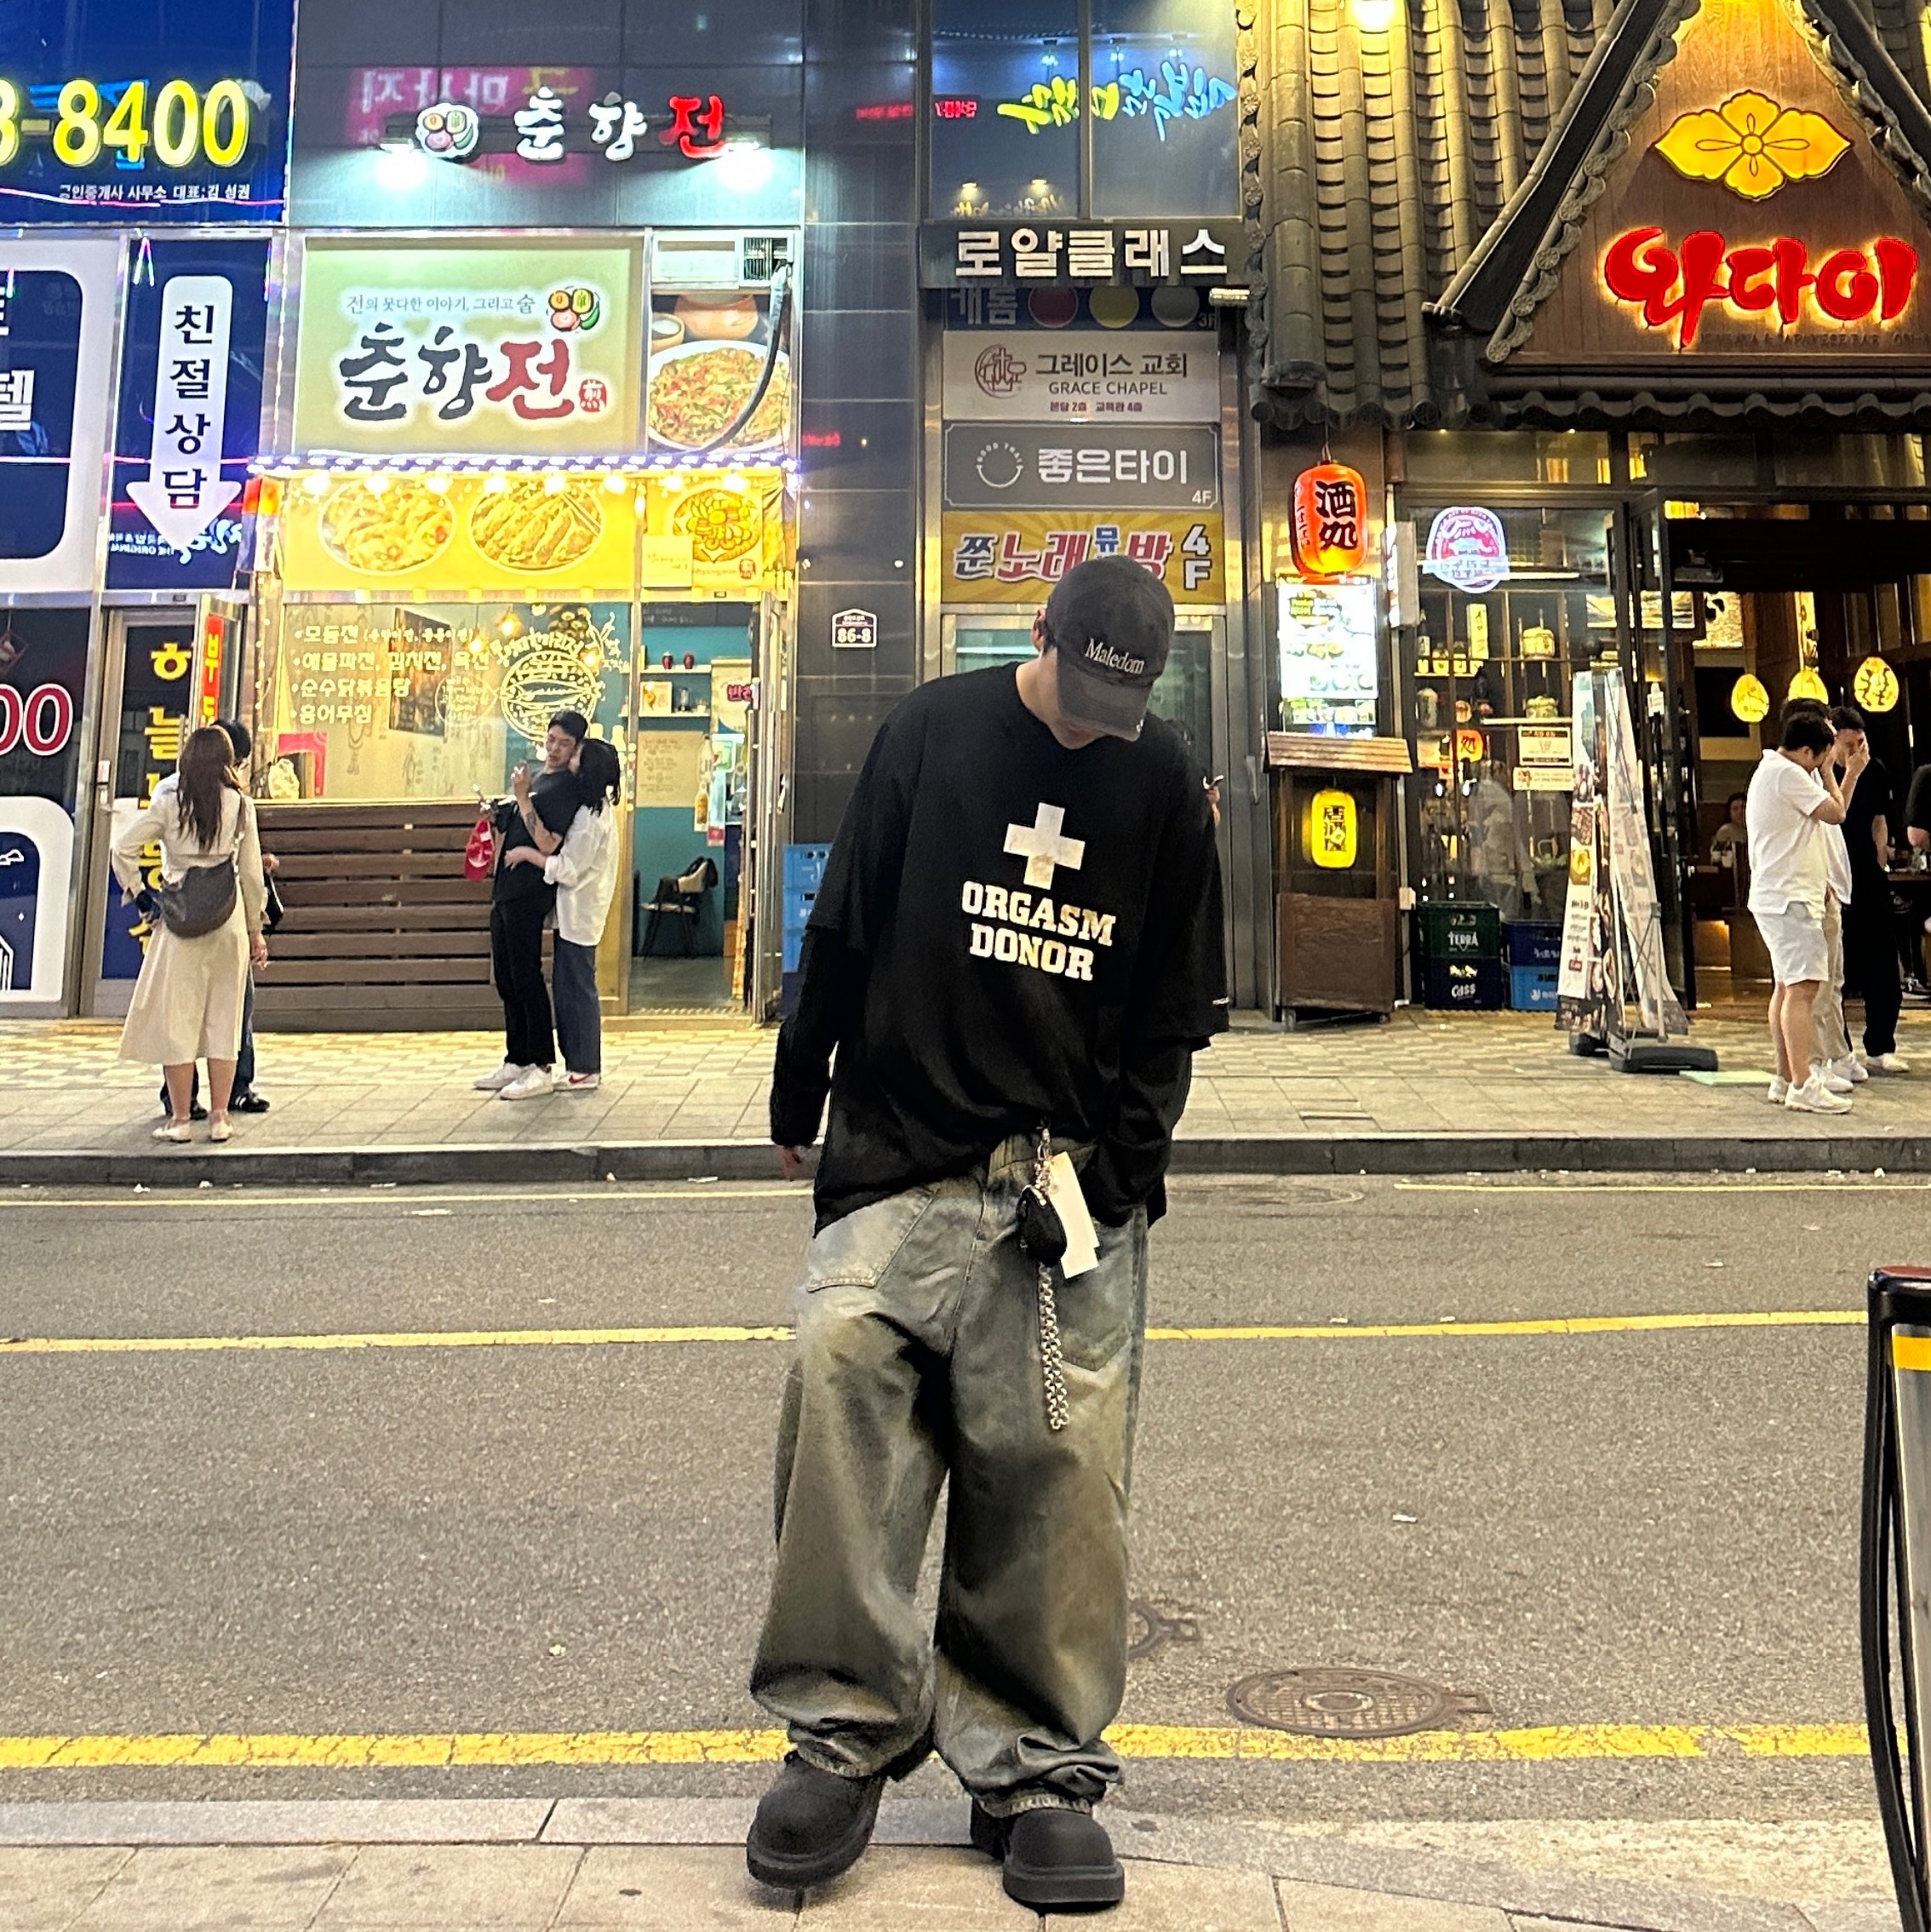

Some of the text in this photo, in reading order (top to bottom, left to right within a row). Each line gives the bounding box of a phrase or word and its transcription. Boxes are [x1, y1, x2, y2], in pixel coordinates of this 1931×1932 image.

[513, 86, 725, 162] 춘향전
[128, 185, 167, 200] 사무소
[955, 227, 1228, 278] 로얄클래스
[347, 294, 536, 314] 전의 못다한 이야기, 그리고 술
[340, 322, 575, 421] 춘향전
[1035, 352, 1188, 378] 그레이스 교회
[1048, 382, 1168, 396] GRACE CHAPEL
[162, 304, 216, 509] 친절상담
[977, 441, 1000, 463] GOOD
[1038, 448, 1188, 484] 좋은타이
[1192, 490, 1212, 504] 4F
[837, 628, 872, 643] 86-8
[961, 880, 1116, 947] ORGASM
[969, 922, 1095, 982] DONOR
[1448, 932, 1479, 947] TERRA
